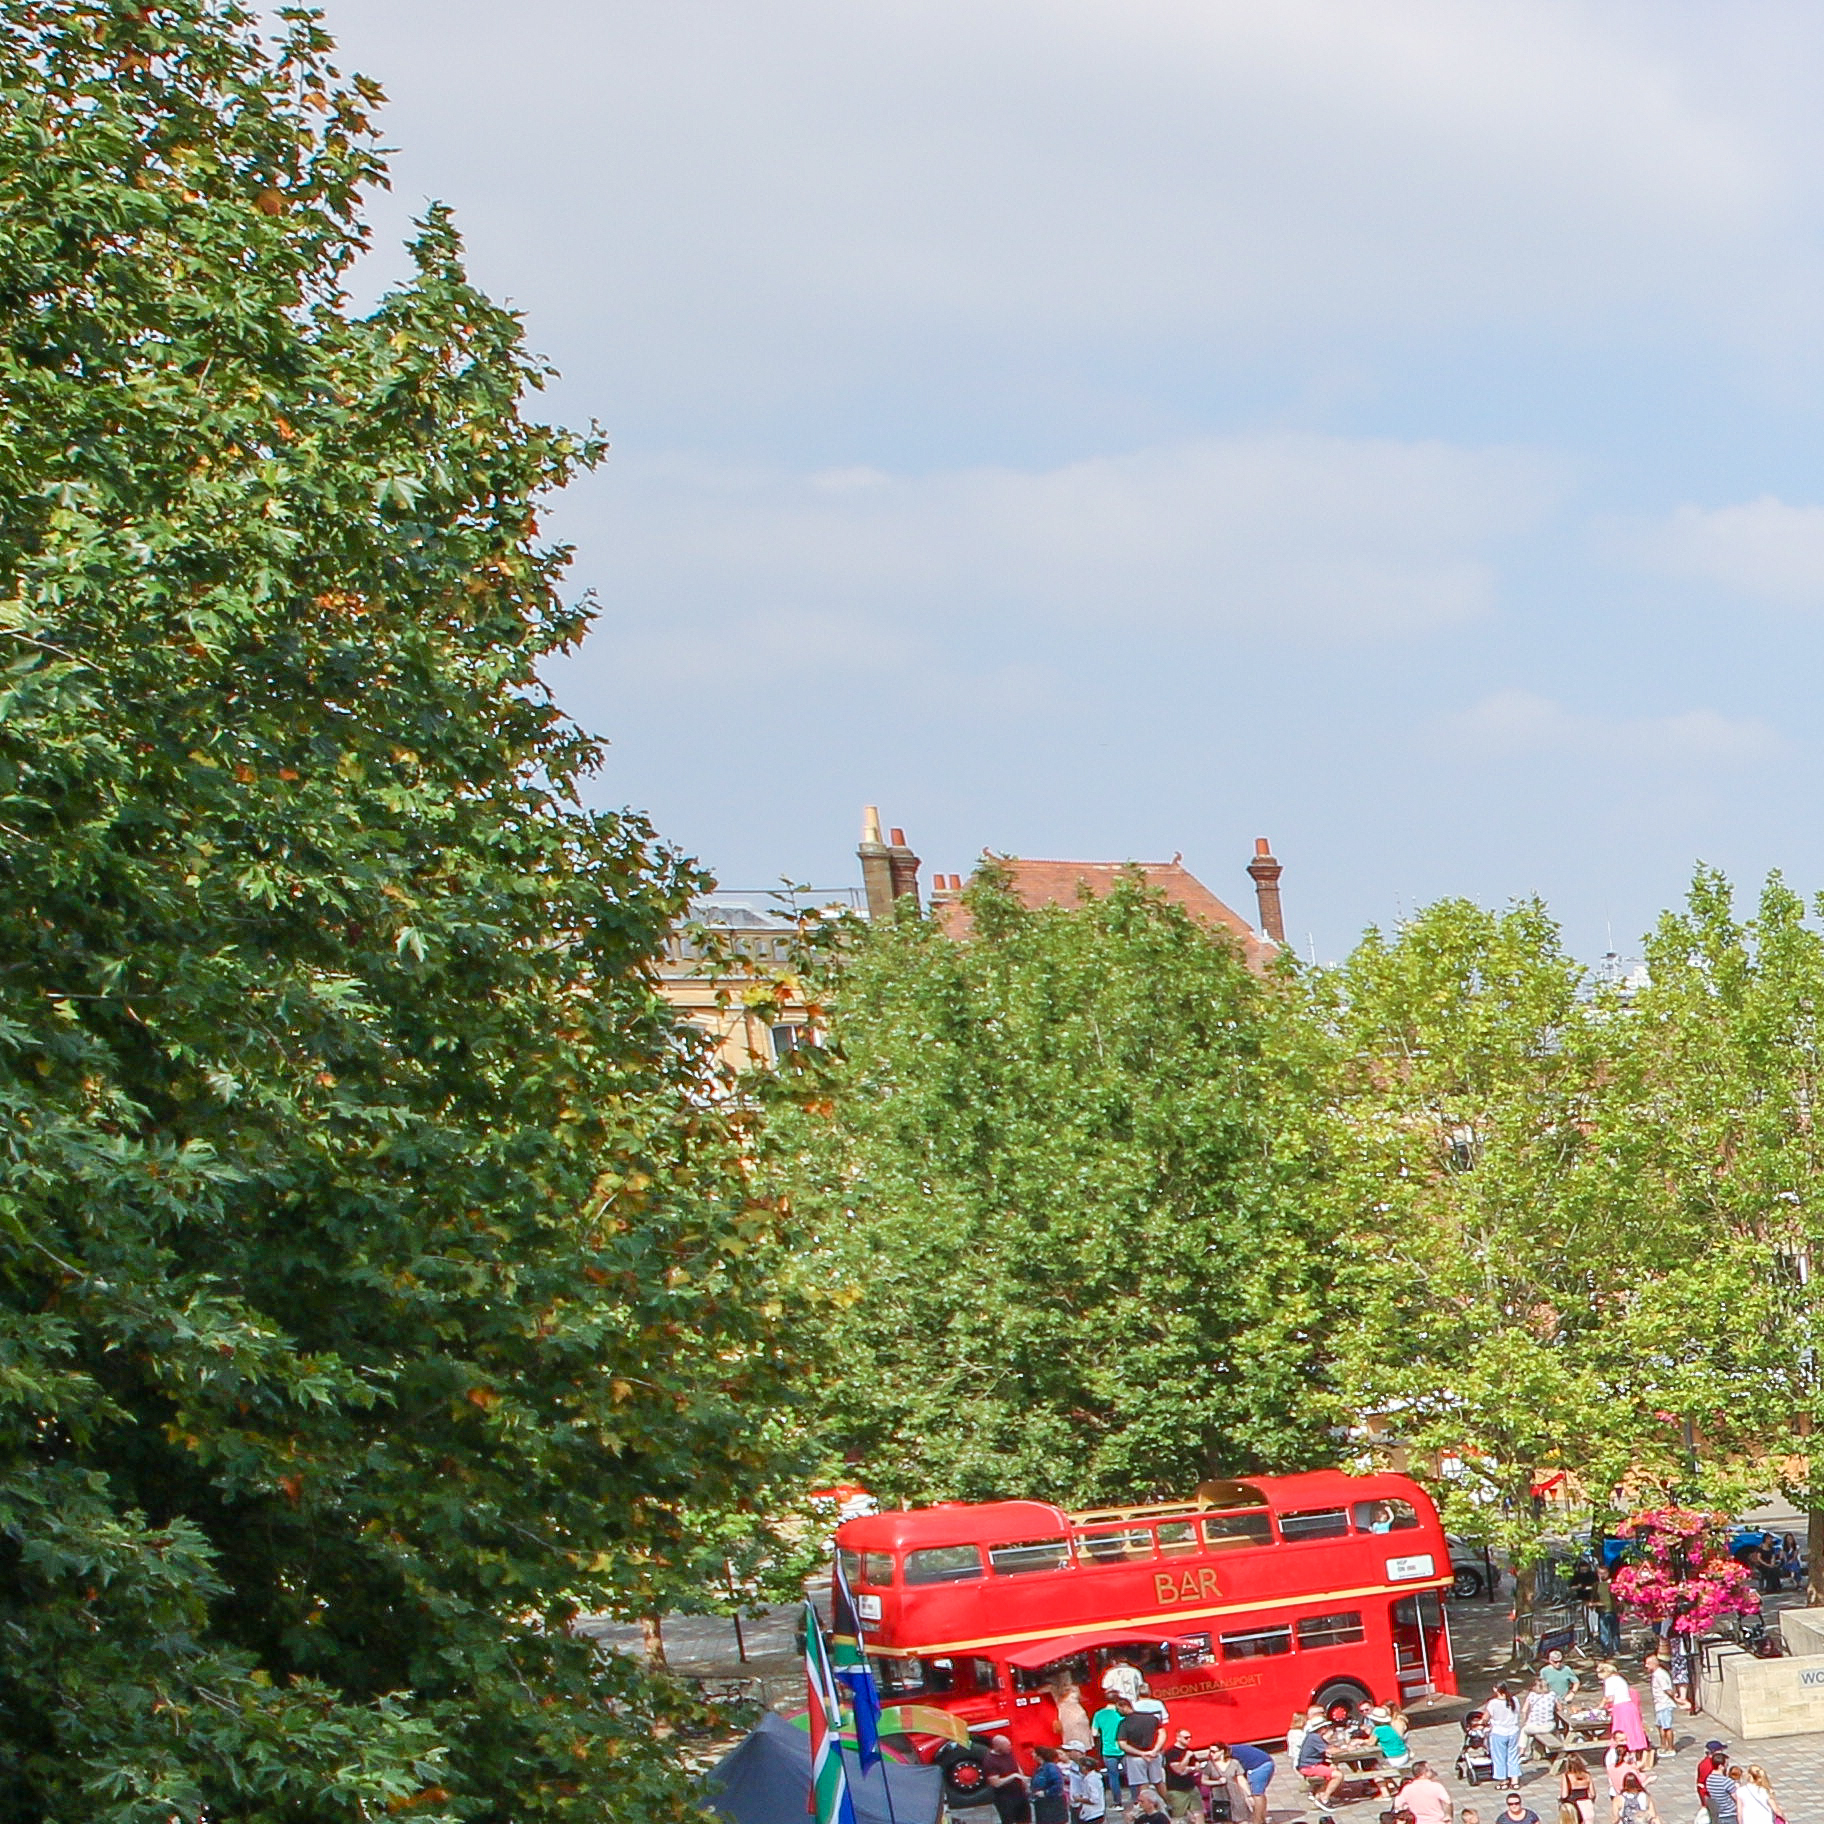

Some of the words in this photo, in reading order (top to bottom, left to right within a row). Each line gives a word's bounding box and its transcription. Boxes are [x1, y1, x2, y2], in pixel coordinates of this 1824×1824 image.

[1154, 1568, 1224, 1606] BAR
[1152, 1682, 1198, 1698] ONDON
[1200, 1673, 1263, 1692] TRANSPORT
